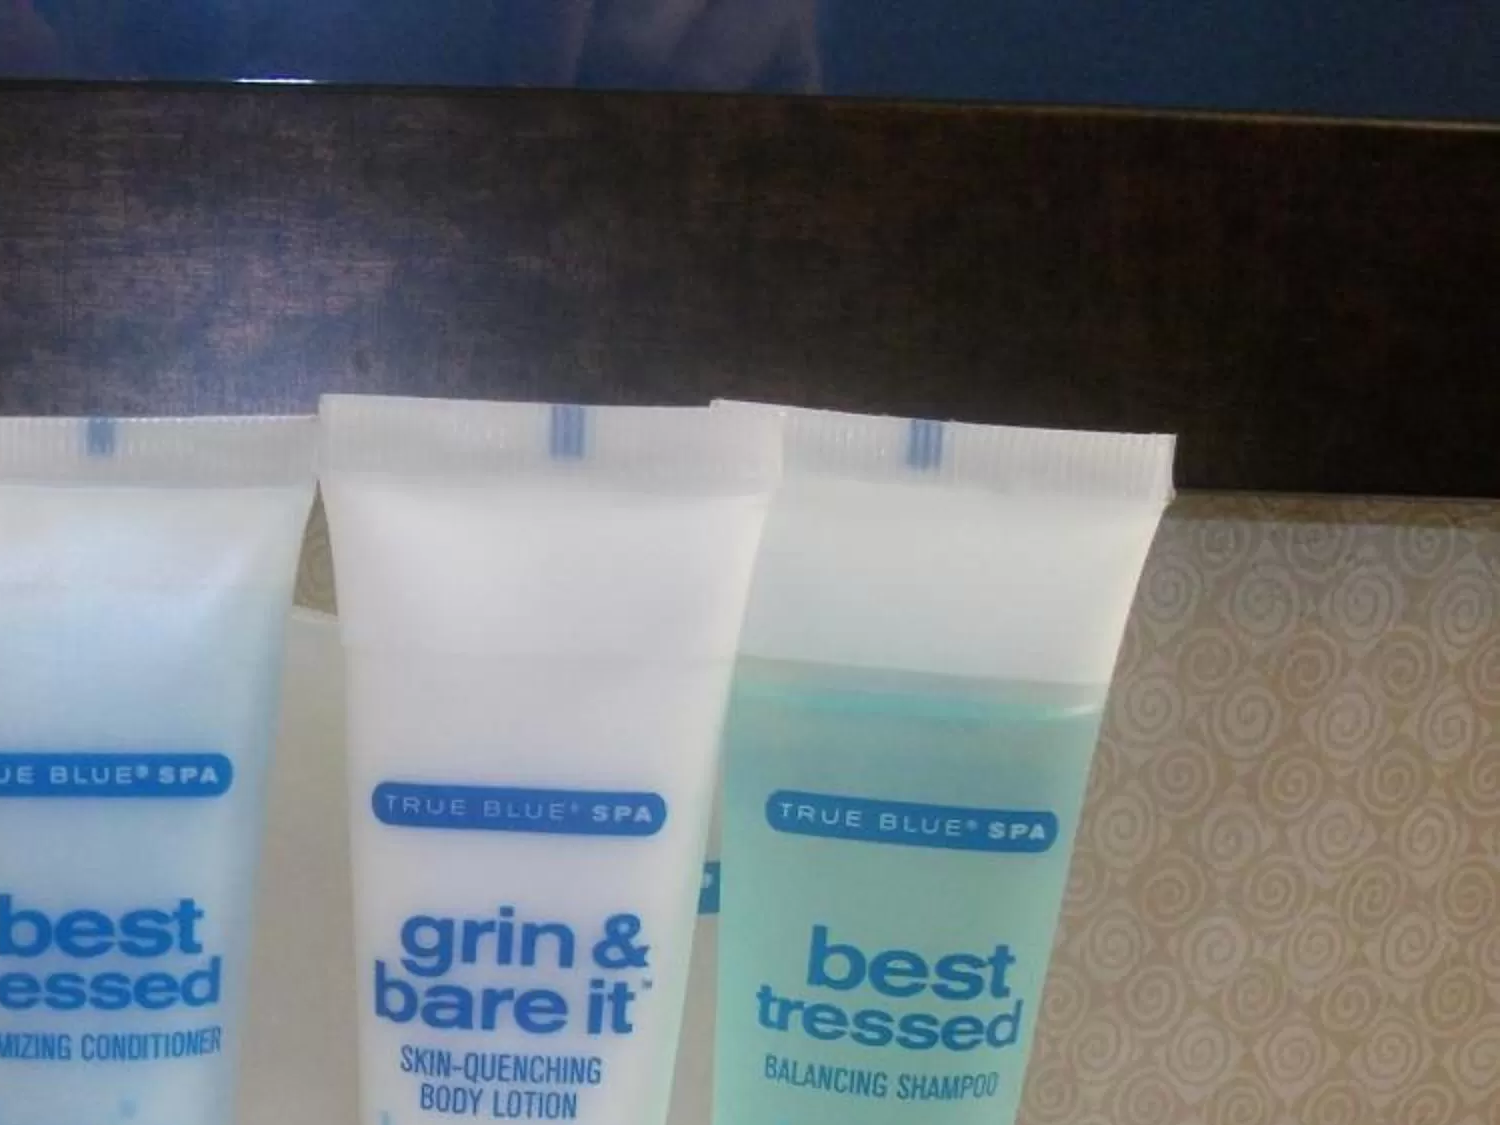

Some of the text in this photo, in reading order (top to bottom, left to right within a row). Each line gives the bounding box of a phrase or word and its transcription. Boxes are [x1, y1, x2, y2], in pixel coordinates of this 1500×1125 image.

[158, 765, 219, 784] SPA
[384, 793, 467, 816] TRUE
[592, 805, 652, 823] SPA
[778, 802, 862, 828] TRUE
[987, 821, 1046, 840] SPA
[400, 906, 650, 977] grin &
[807, 924, 1016, 1000] best
[374, 959, 569, 1034] bare
[756, 984, 1024, 1051] tressed
[81, 1025, 221, 1062] CONDITIONER
[400, 1044, 603, 1085] SKIN-QUENCHING
[765, 1054, 999, 1101] BALANCING SHAMPOO
[420, 1083, 578, 1120] BODY LOTION
